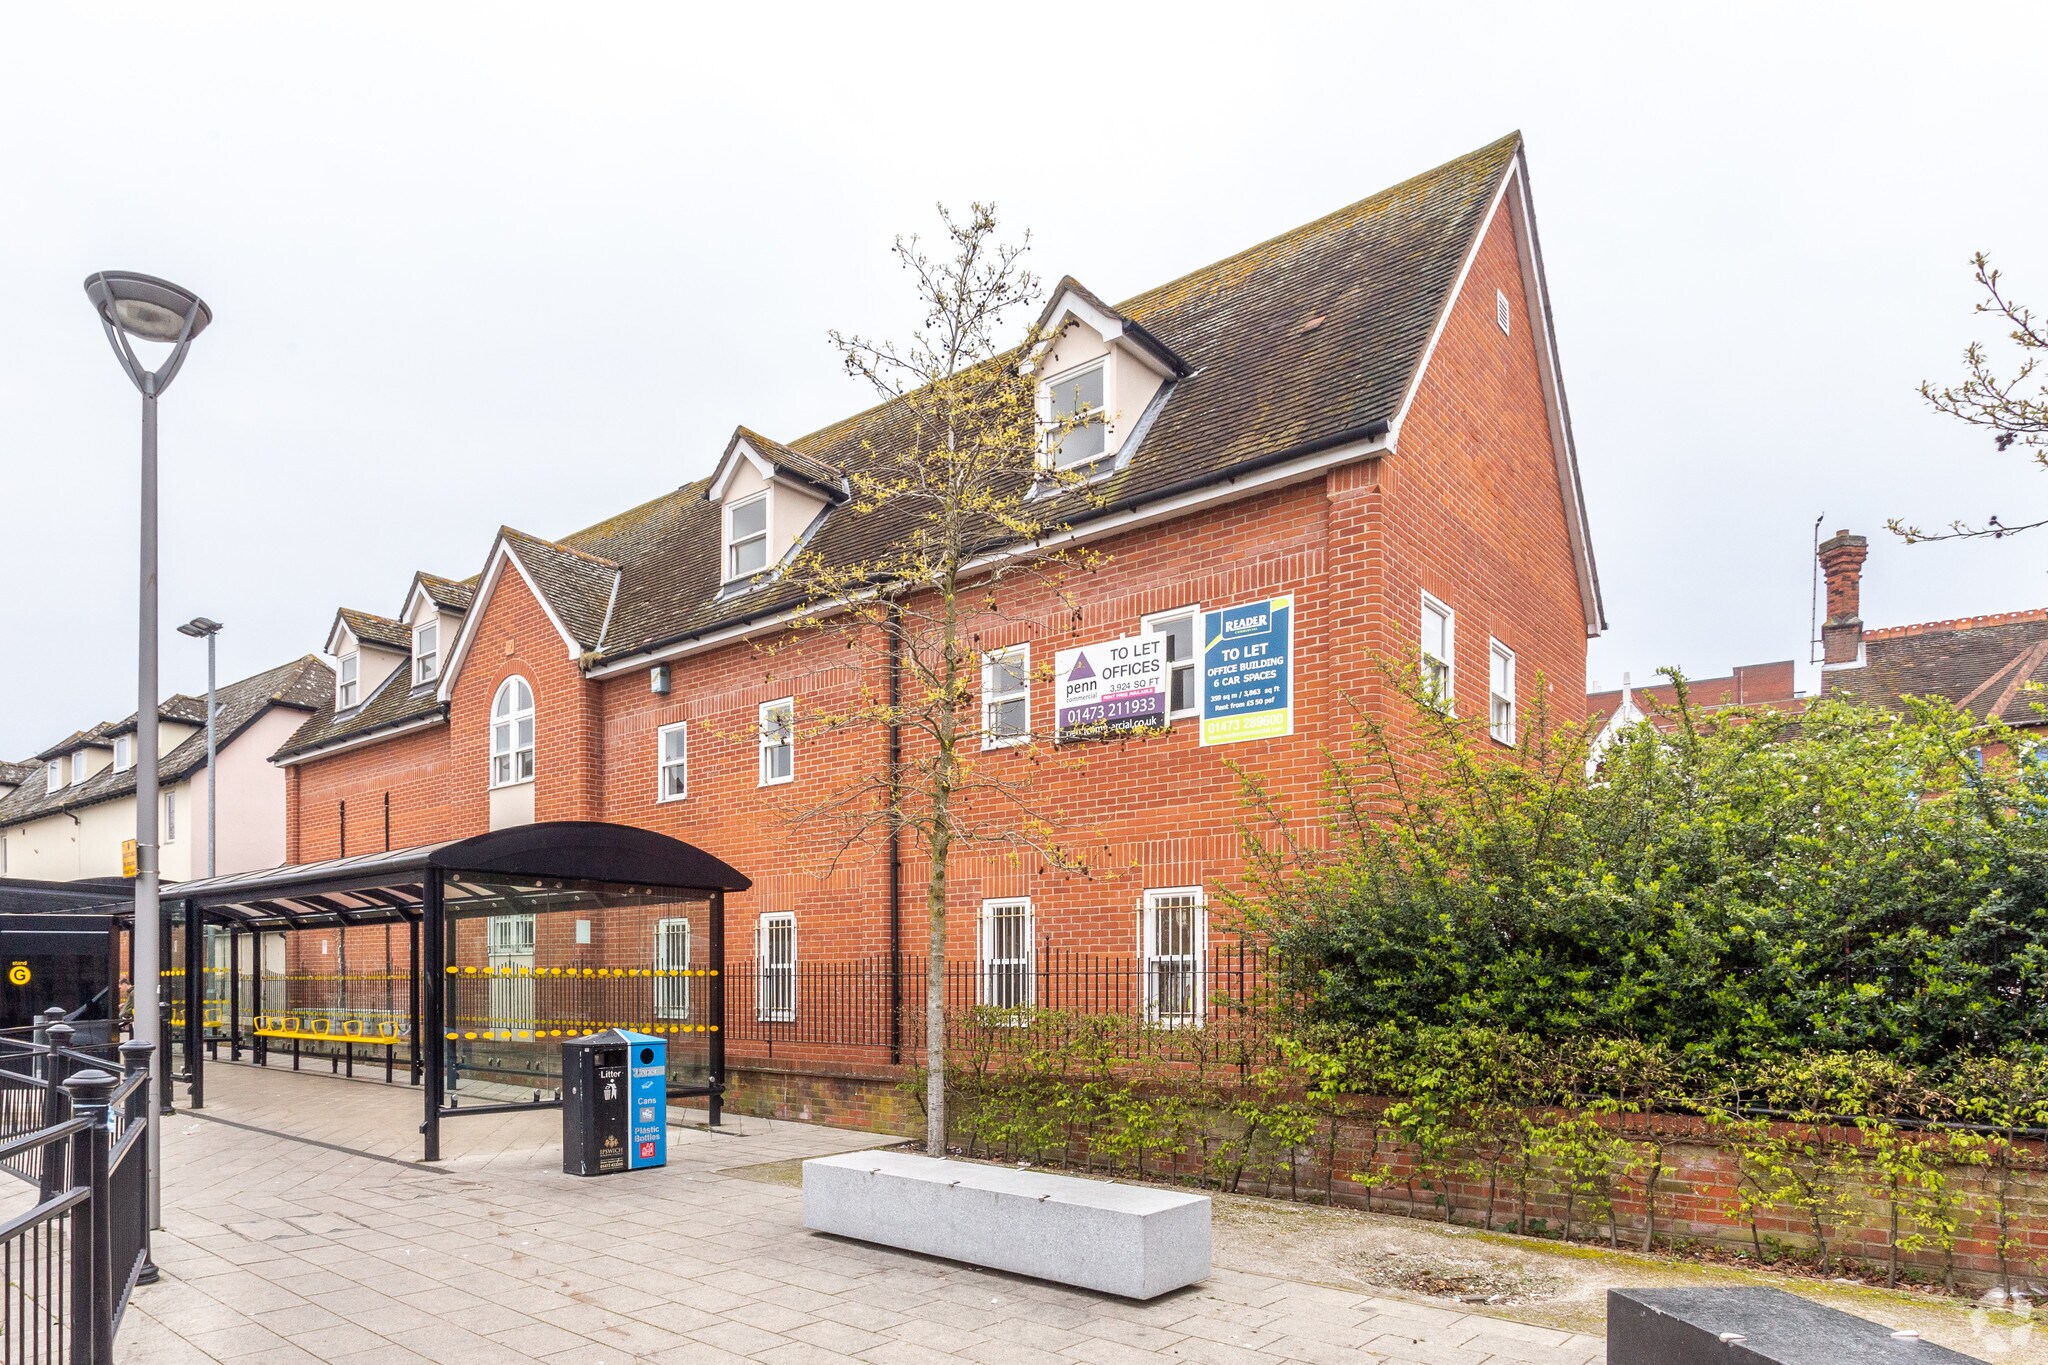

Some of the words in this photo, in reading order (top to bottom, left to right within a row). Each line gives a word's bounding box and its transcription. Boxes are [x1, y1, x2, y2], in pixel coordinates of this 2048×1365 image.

[1225, 614, 1267, 633] READER
[1110, 647, 1128, 661] TO
[1134, 641, 1160, 657] LET
[1222, 648, 1240, 662] TO
[1244, 642, 1269, 657] LET
[1102, 659, 1160, 680] OFFICES
[1207, 664, 1238, 677] OFFICE
[1240, 656, 1284, 671] BUILDING
[1134, 679, 1146, 689] SQ
[1149, 677, 1160, 687] FT
[1213, 678, 1220, 688] 6
[1222, 675, 1241, 686] CAR
[1243, 670, 1277, 683] SPACES
[1066, 680, 1098, 698] penn
[1066, 692, 1098, 703] commercial
[1067, 705, 1105, 723] 01473
[1107, 697, 1156, 717] 211933
[1214, 703, 1229, 712] Rent
[1230, 701, 1245, 709] from
[1207, 719, 1240, 734] 01473
[1243, 713, 1284, 729] 289600
[14, 969, 26, 981] G
[600, 1070, 621, 1079] Litter
[637, 1097, 657, 1105] Cans
[634, 1126, 660, 1134] Plastic
[634, 1132, 661, 1142] Bottles
[600, 1147, 623, 1155] IPSWICH
